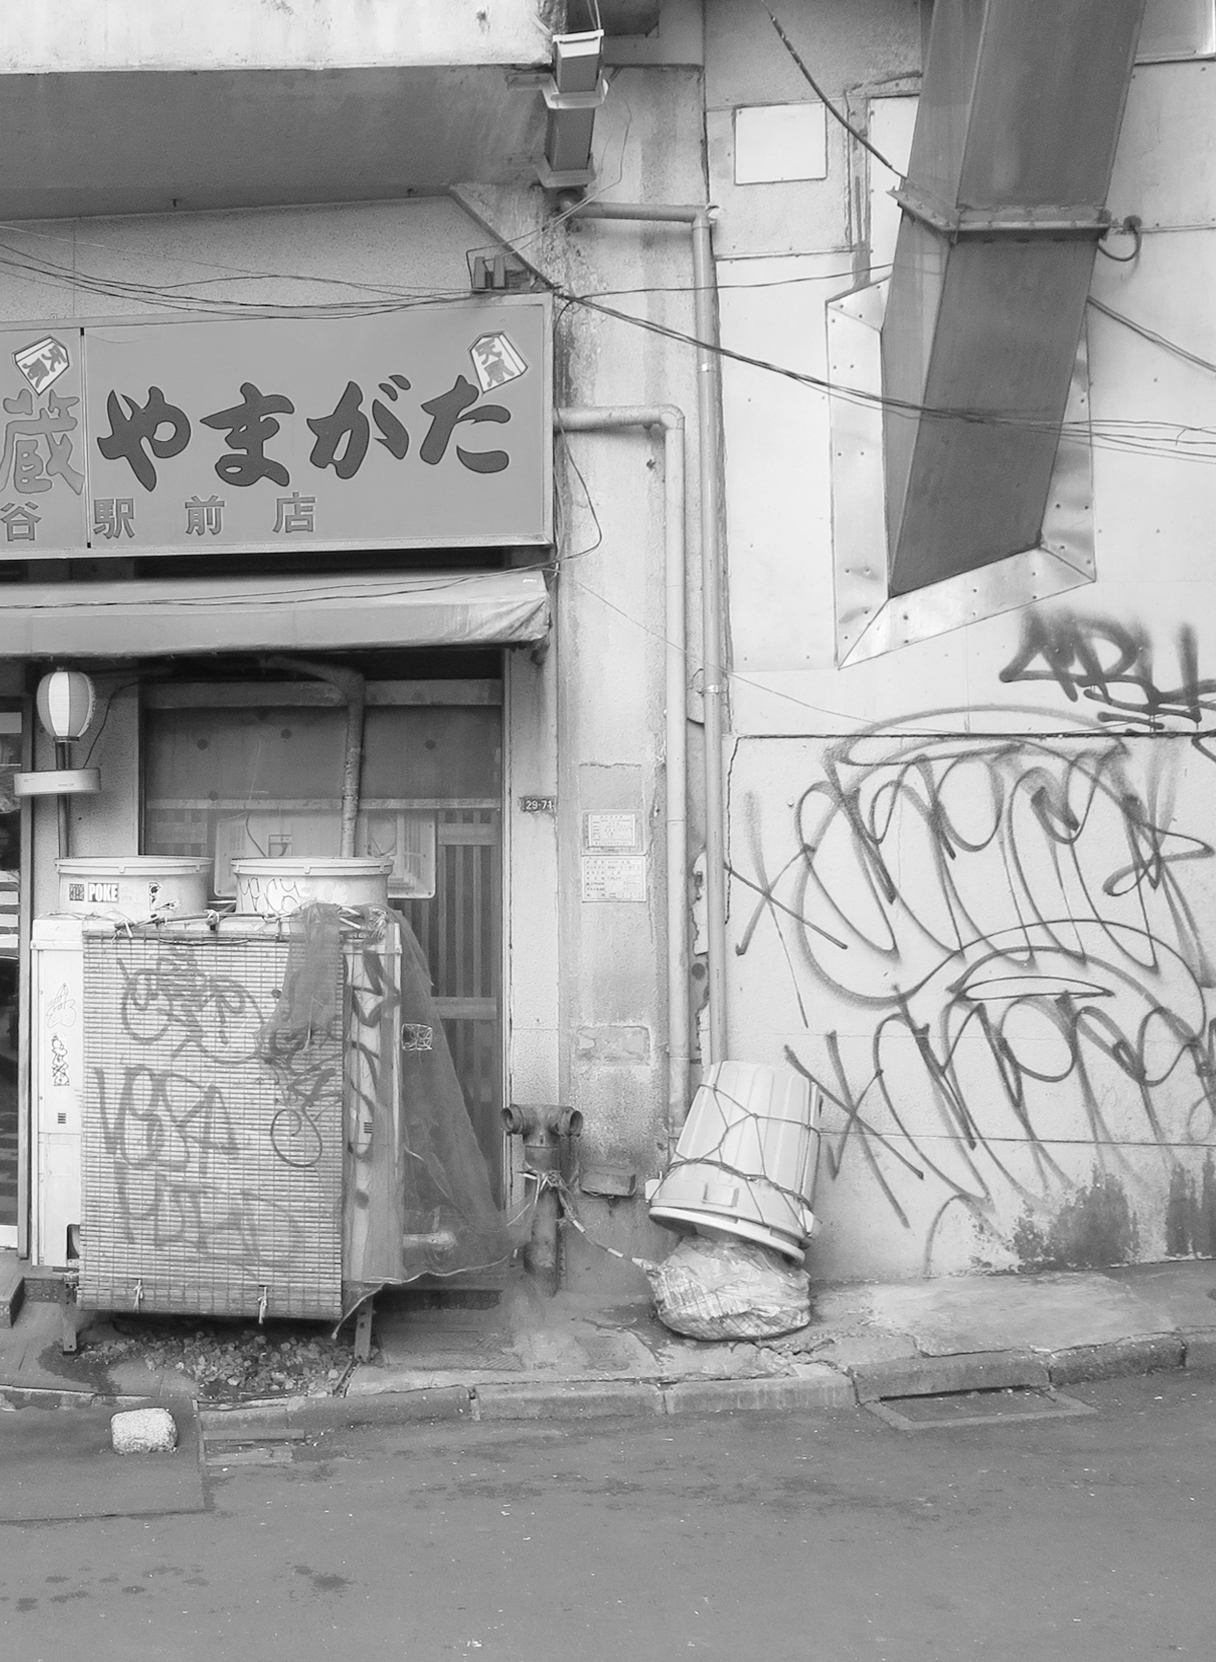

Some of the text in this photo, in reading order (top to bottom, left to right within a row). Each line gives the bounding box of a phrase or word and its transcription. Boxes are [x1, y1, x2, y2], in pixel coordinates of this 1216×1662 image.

[96, 374, 512, 492] やまがた
[88, 882, 118, 901] POKE
